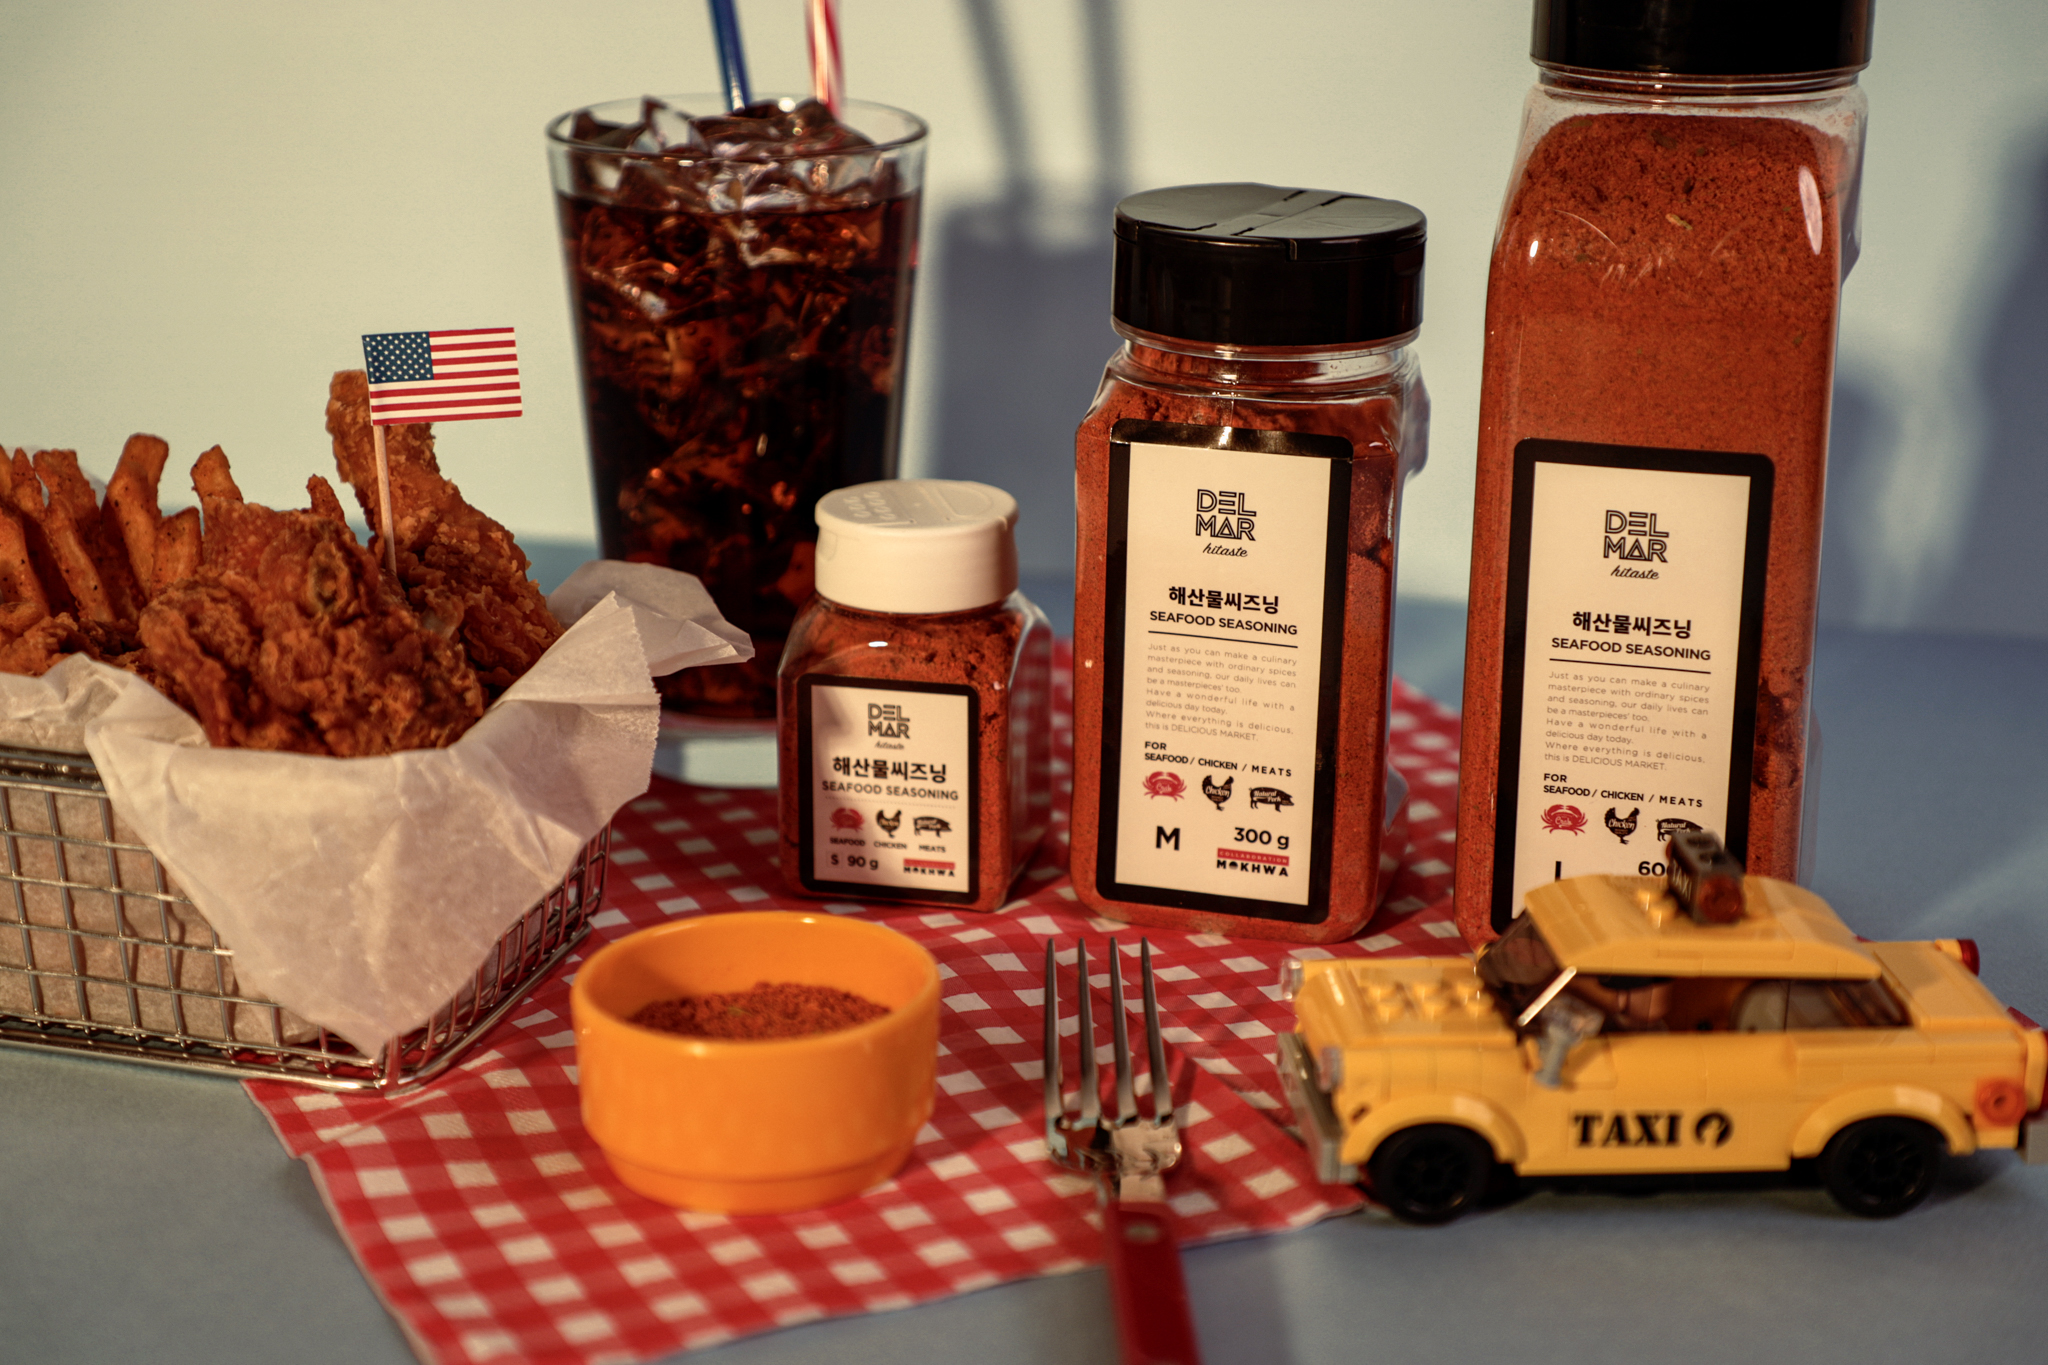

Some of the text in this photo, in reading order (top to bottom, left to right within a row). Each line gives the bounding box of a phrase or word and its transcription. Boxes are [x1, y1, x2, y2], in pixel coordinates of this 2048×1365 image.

[1196, 489, 1257, 517] DEL
[1196, 514, 1256, 541] MAR
[1605, 510, 1669, 538] DEL
[1203, 543, 1248, 557] hitaste
[1603, 535, 1668, 563] MAR
[1611, 565, 1659, 579] hitaste
[1169, 586, 1279, 614] 해산물씨즈닝
[1150, 611, 1297, 635] SEAFOOD SEASONING
[1573, 611, 1691, 639] 해산물씨즈닝
[1148, 643, 1166, 651] Just
[1184, 647, 1200, 655] you
[1225, 651, 1248, 660] make
[1261, 655, 1297, 666] culinary
[1552, 637, 1711, 660] SEAFOOD SEASONING
[1148, 655, 1201, 666] masterpiece
[1228, 663, 1264, 674] ordinary
[1269, 668, 1296, 677] spices
[1234, 675, 1254, 684] daily
[1258, 678, 1276, 686] lives
[1549, 671, 1569, 679] Just
[1588, 675, 1605, 683] you
[1631, 678, 1657, 687] make
[1671, 681, 1710, 693] culinary
[1187, 693, 1237, 704] wonderful
[1242, 698, 1258, 706] life
[1263, 701, 1284, 710] with
[1548, 683, 1709, 704] masterpiece with ordinary spices
[868, 703, 910, 722] DEL
[1146, 700, 1182, 709] delicious
[1185, 703, 1200, 713] day
[1547, 706, 1558, 714] be
[1641, 702, 1663, 712] daily
[1667, 704, 1687, 713] lives
[1146, 711, 1176, 719] Where
[1181, 714, 1232, 727] everything
[1546, 718, 1572, 726] Have
[1589, 722, 1644, 733] wonderful
[1650, 726, 1667, 735] life
[1673, 729, 1696, 737] with
[868, 720, 910, 739] MAR
[1172, 725, 1217, 736] DELICIOUS
[1546, 730, 1584, 739] delicious
[1587, 733, 1603, 742] day
[1145, 741, 1167, 750] FOR
[1545, 741, 1578, 750] Where
[1583, 744, 1638, 757] everything
[1198, 758, 1237, 770] CHICKEN
[1252, 765, 1292, 776] MEATS
[1544, 753, 1560, 761] this
[1572, 755, 1622, 766] DELICIOUS
[832, 756, 946, 784] 해산물씨즈닝
[1544, 773, 1567, 783] FOR
[822, 780, 958, 800] SEAFOOD SEASONING
[1205, 786, 1230, 798] Chicken
[1601, 790, 1644, 801] CHICKEN
[1659, 796, 1702, 807] MEATS
[1608, 818, 1635, 830] Chicken
[830, 837, 865, 846] SEAFOOD
[874, 841, 907, 849] CHICKEN
[1156, 825, 1180, 851] M
[1234, 827, 1289, 850] 300 g
[831, 854, 878, 870] S 90 g
[1219, 850, 1288, 864] COLLABORATION
[1638, 861, 1670, 877] 60
[1574, 1113, 1682, 1146] TAXI
